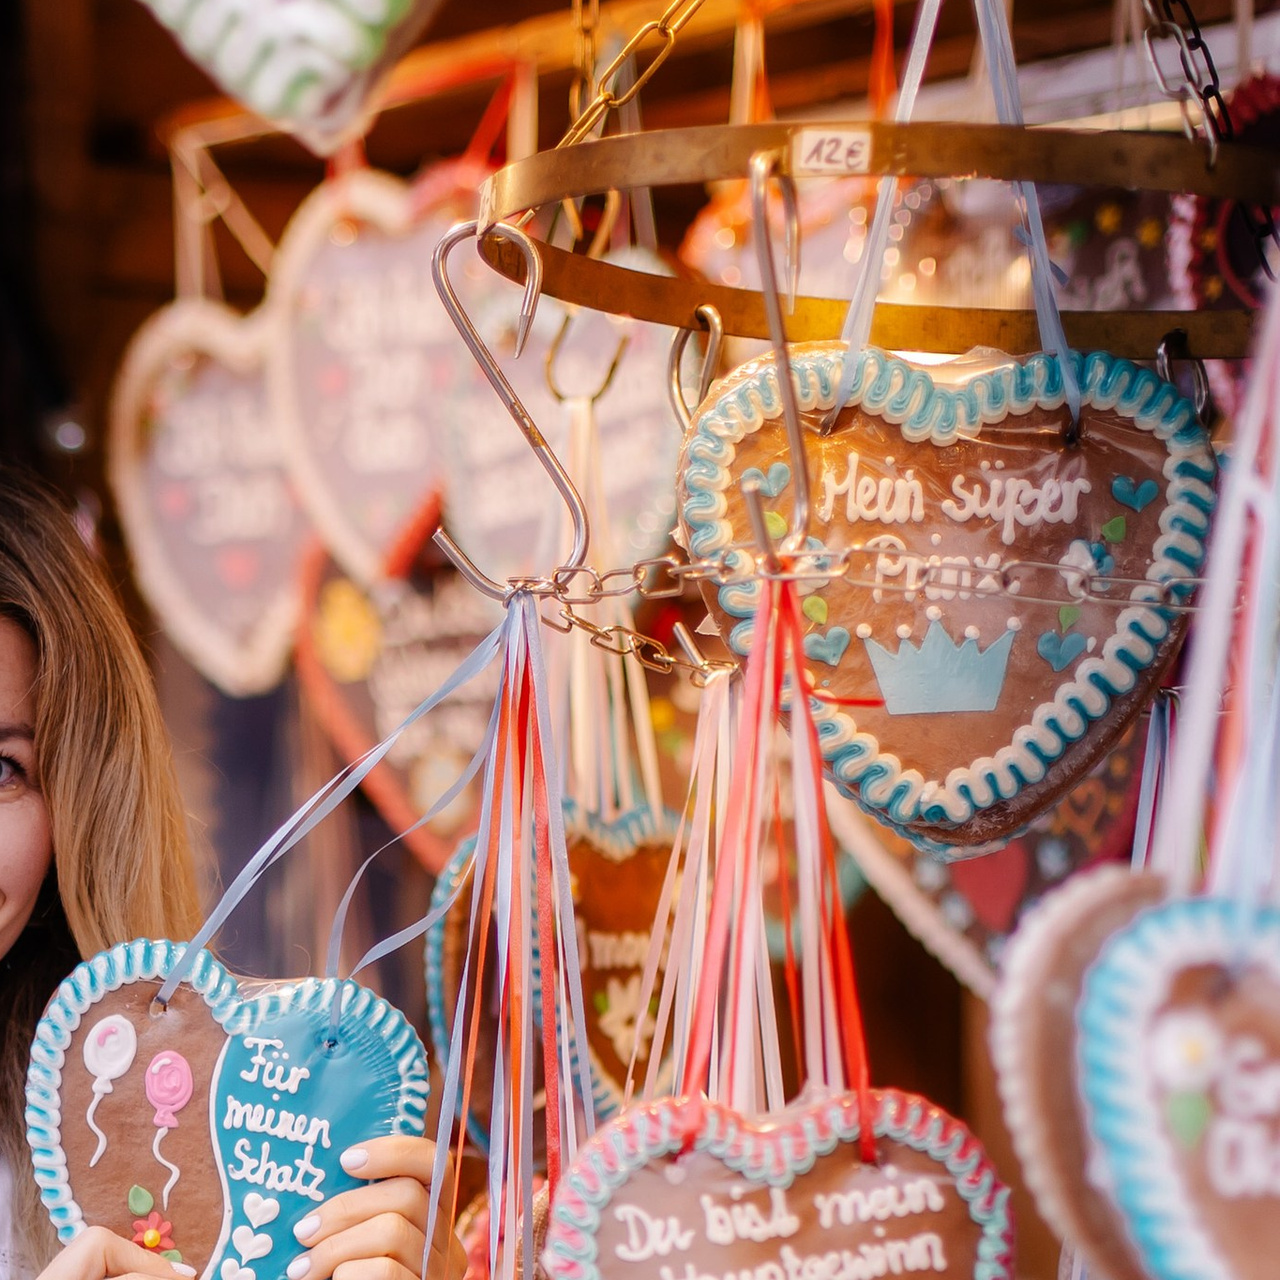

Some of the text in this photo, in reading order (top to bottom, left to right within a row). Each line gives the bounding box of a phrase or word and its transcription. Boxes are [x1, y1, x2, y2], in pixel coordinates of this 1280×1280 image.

[804, 137, 866, 170] 12€
[941, 459, 1093, 546] süßer
[239, 1036, 311, 1094] Für
[223, 1093, 332, 1150] meinen
[228, 1137, 327, 1202] Schatz
[613, 1164, 946, 1263] Du bist mein
